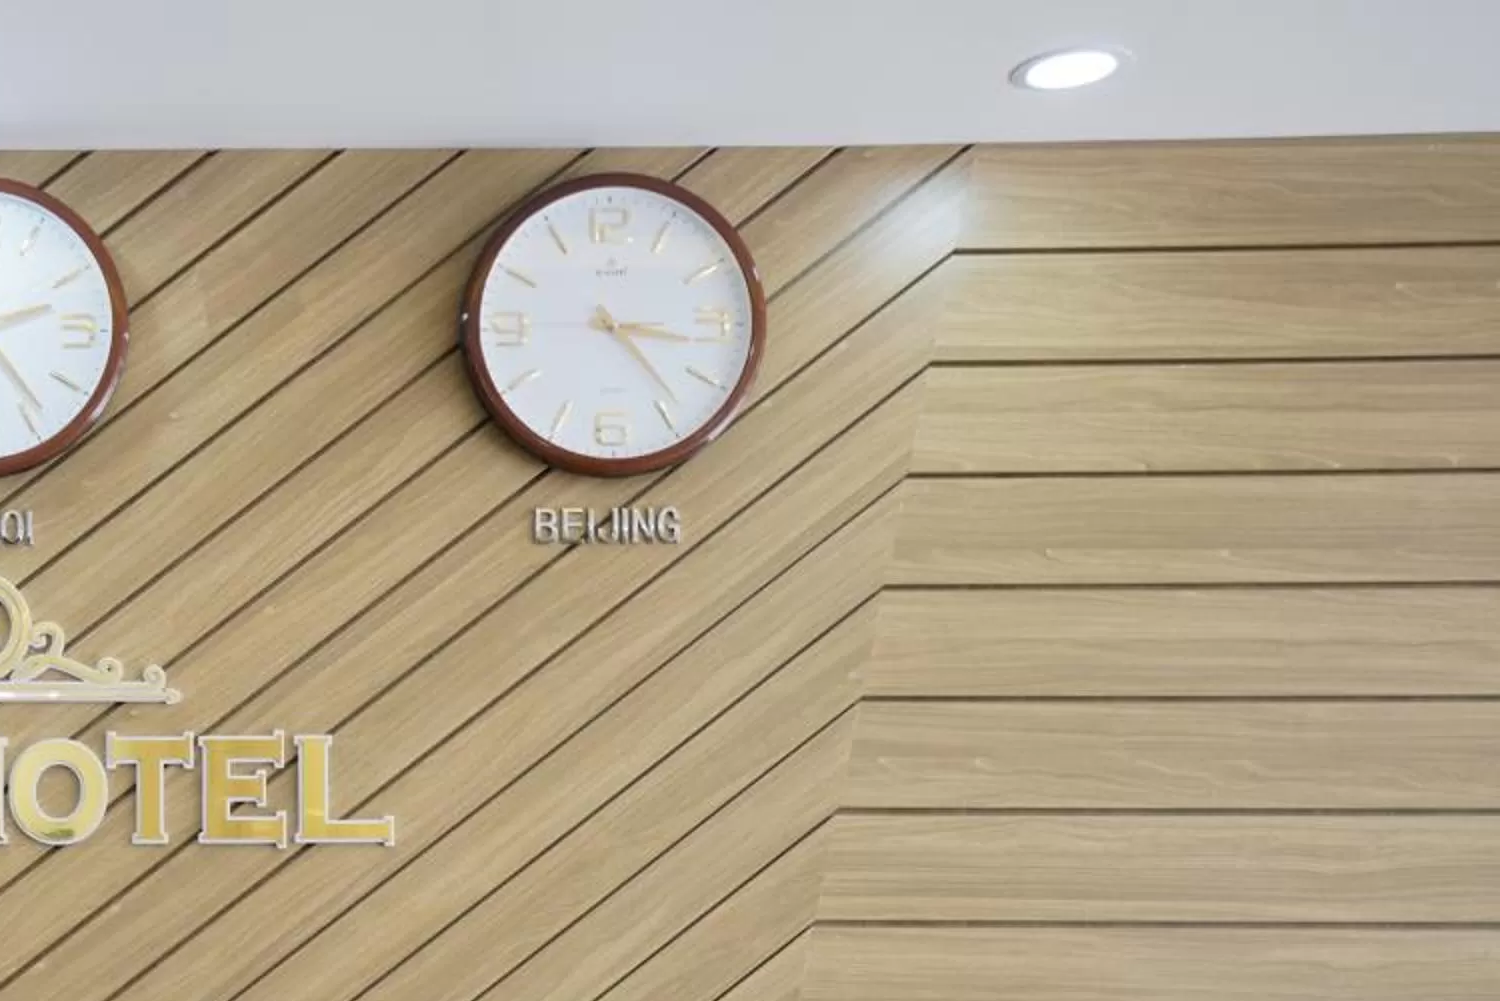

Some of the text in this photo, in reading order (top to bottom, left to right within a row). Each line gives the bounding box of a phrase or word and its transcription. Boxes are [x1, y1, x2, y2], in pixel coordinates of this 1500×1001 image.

[62, 313, 97, 349] 3
[594, 412, 628, 447] 6
[532, 507, 682, 545] BEIJING
